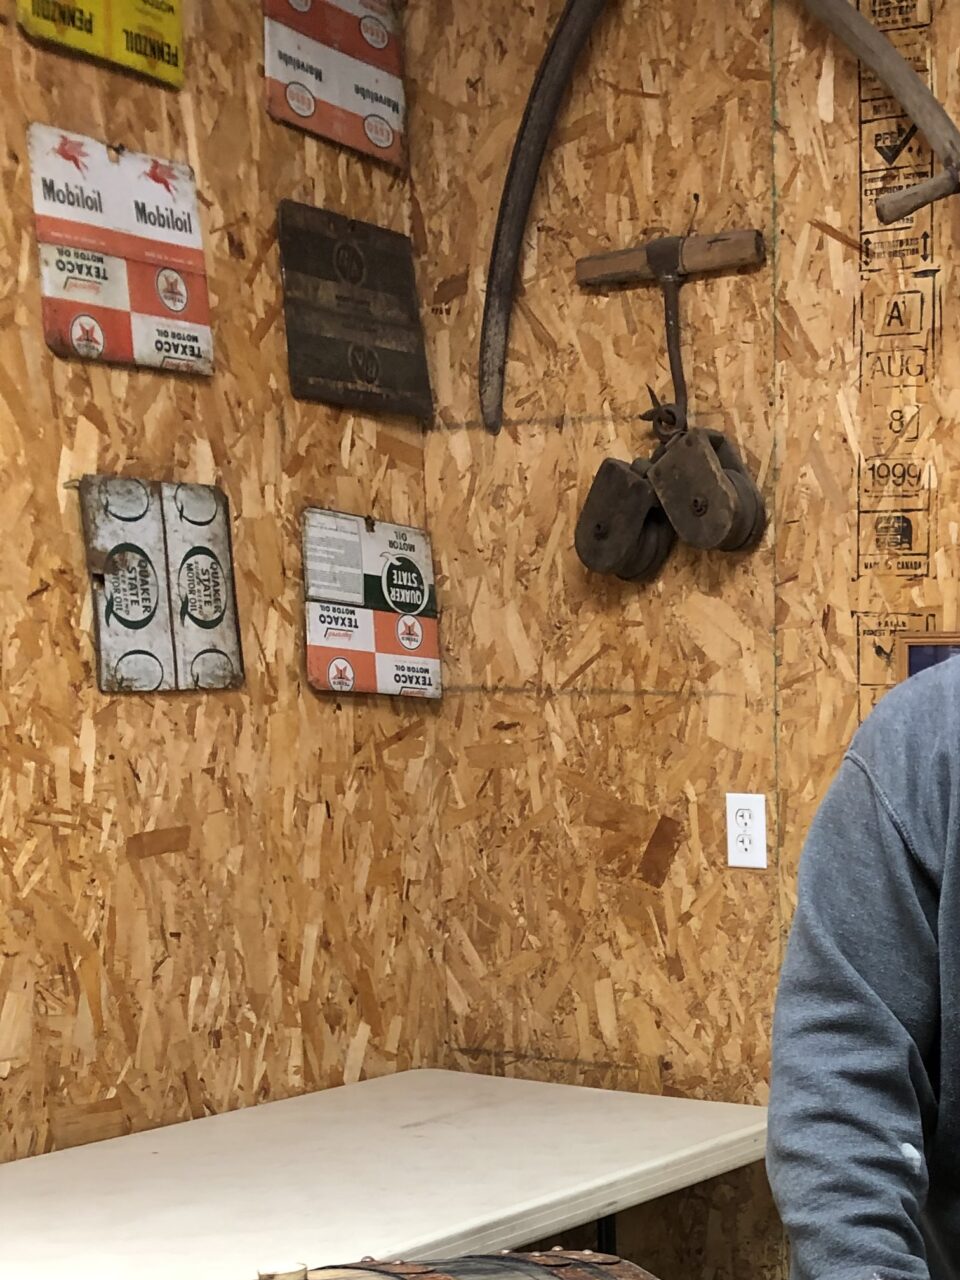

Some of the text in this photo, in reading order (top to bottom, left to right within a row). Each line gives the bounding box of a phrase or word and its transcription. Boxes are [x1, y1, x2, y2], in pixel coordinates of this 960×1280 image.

[122, 28, 179, 67] PENNZOIL
[277, 50, 323, 82] Marvelube
[354, 83, 399, 114] Marvelube
[41, 176, 103, 214] Mobiloil
[134, 199, 193, 234] Mobiloil
[74, 250, 104, 264] MOTOR
[56, 259, 108, 281] TEXACO
[887, 300, 904, 327] A
[156, 328, 198, 343] MOTOR OIL
[155, 339, 203, 358] TEXACO
[870, 354, 924, 380] AUG
[889, 409, 904, 434] 8
[868, 462, 922, 487] 1999
[388, 540, 416, 552] MOTOR
[394, 530, 408, 542] OIL
[896, 560, 922, 570] CANADA
[127, 566, 139, 607] STATE
[138, 558, 151, 614] QUAKER
[186, 562, 198, 612] MOTOR OIL
[201, 568, 212, 607] STATE
[209, 561, 222, 614] QUAKER
[392, 569, 418, 587] STATE
[114, 598, 123, 612] OIL
[390, 587, 422, 605] QUAKER
[319, 613, 358, 628] TEXACO
[320, 604, 356, 615] MOTOR OIL
[393, 673, 432, 687] TEXACO
[406, 665, 430, 674] MOTOR
